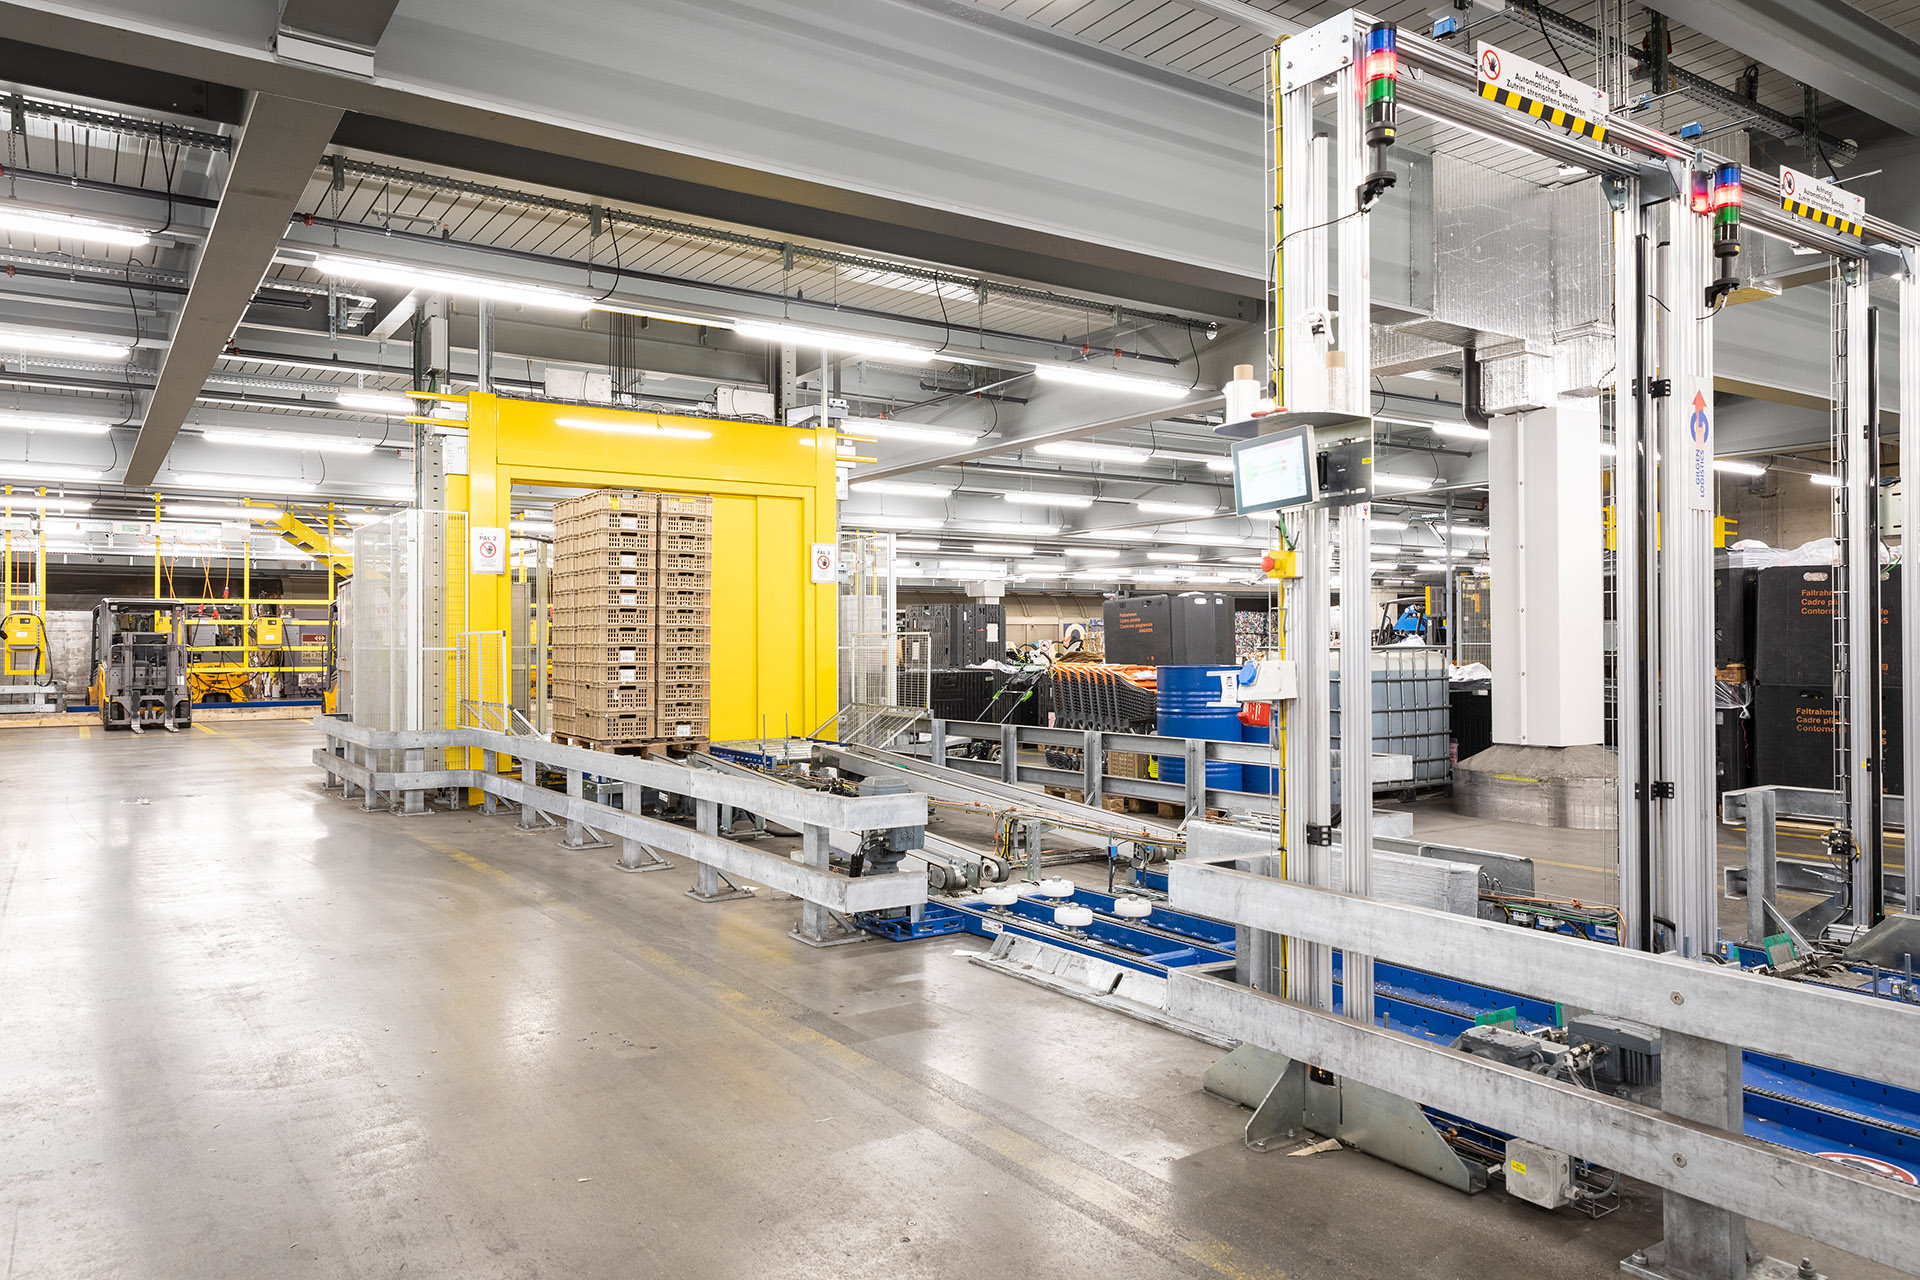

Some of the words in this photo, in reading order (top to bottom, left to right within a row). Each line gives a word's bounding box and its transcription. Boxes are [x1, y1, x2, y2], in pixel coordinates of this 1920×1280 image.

[1535, 70, 1560, 88] Achtung!
[1515, 72, 1558, 95] Automatischer
[1559, 89, 1579, 104] Betrieb
[1506, 79, 1526, 93] Zutritt
[1527, 88, 1560, 108] strengstens
[1562, 100, 1587, 117] verboten
[1816, 185, 1832, 198] Achtung!
[1798, 193, 1811, 202] Zutritt
[1811, 198, 1833, 212] strengstens
[1803, 188, 1831, 203] Automatischer
[1831, 198, 1845, 209] Betrieb
[1801, 598, 1826, 606] Cadre
[1828, 599, 1839, 608] pli
[1801, 607, 1839, 615] Contorno
[1796, 707, 1841, 716] Faltrahme
[1796, 715, 1821, 723] Cadre
[1796, 724, 1836, 733] Contorno
